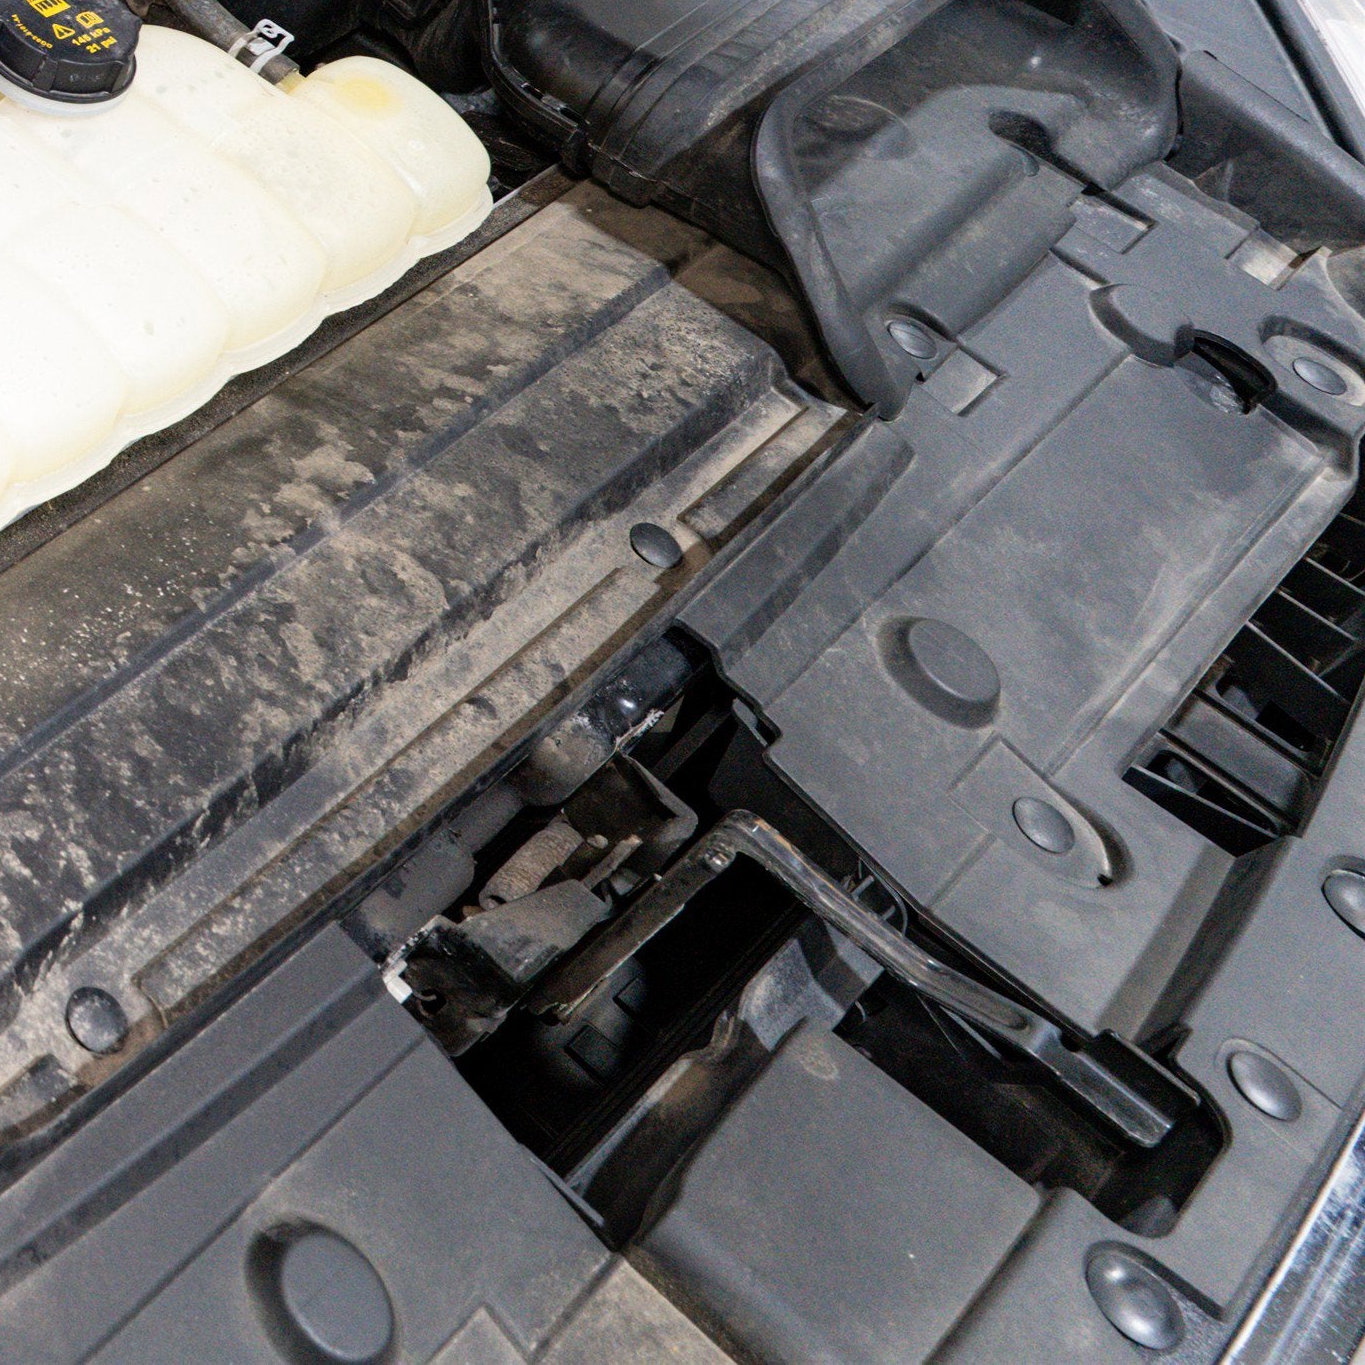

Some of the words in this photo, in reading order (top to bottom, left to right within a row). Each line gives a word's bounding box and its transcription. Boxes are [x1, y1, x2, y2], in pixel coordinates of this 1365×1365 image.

[89, 27, 111, 39] kPa
[86, 43, 102, 54] 21
[100, 36, 118, 49] psi
